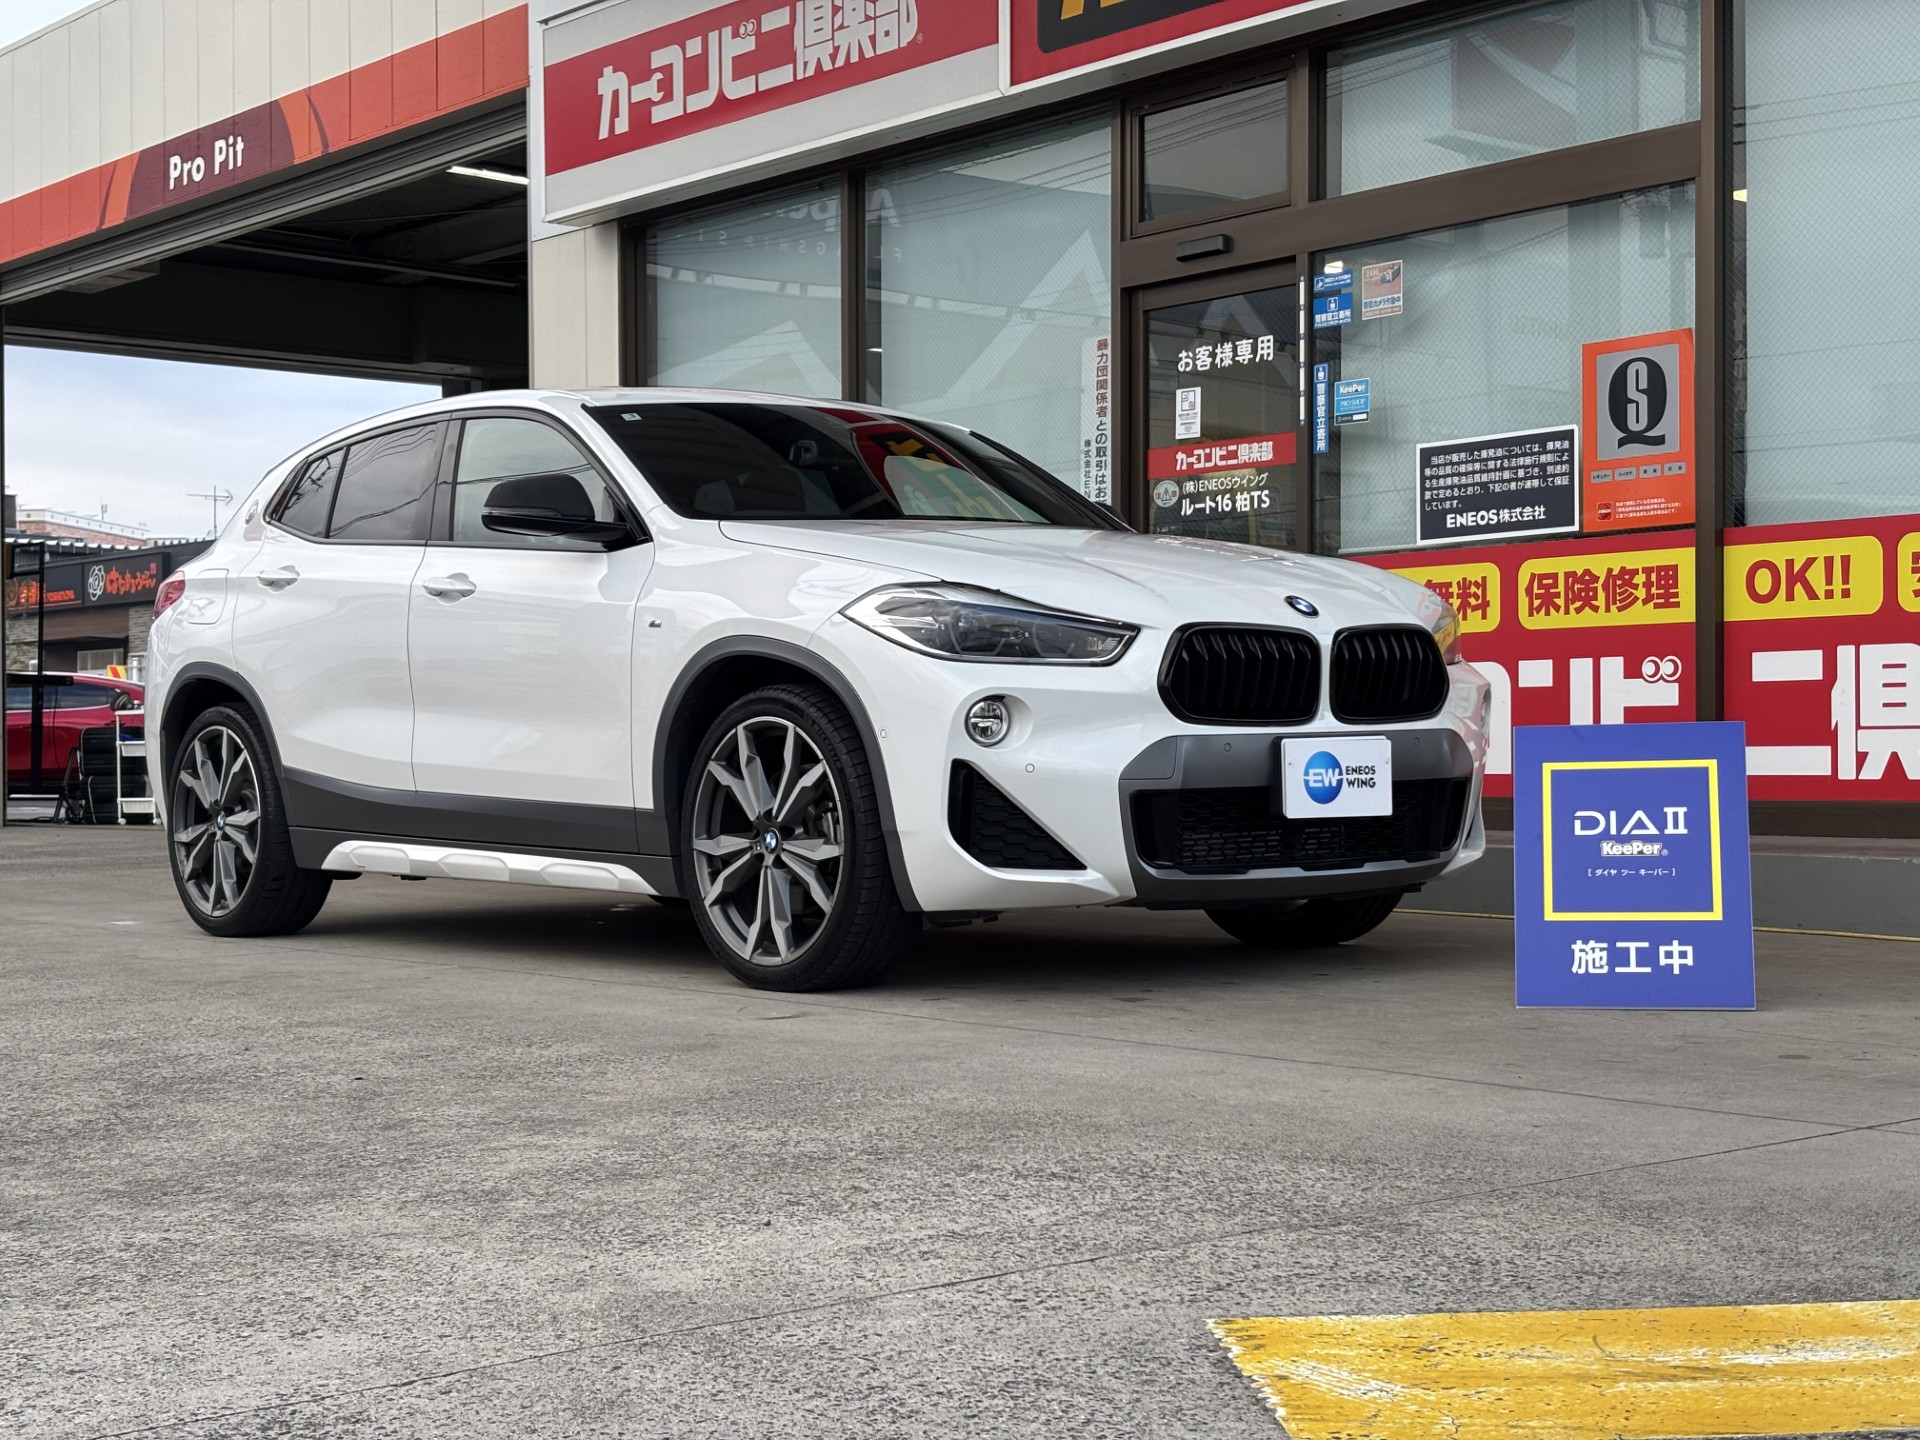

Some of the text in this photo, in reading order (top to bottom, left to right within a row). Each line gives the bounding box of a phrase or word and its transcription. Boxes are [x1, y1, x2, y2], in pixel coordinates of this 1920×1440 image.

[597, 0, 918, 140] カーコンビニ倶楽部
[169, 135, 244, 190] Pro Pit
[1177, 335, 1274, 372] お客様専用
[1339, 383, 1366, 394] KeePer
[1175, 441, 1274, 471] カーコンビニ倶楽部
[1181, 490, 1270, 516] ルート16 柏TS
[1425, 500, 1462, 511] しています。
[1446, 505, 1546, 529] ENEOS株式会社
[1524, 564, 1681, 618] 保険修理
[1744, 554, 1852, 604] OK!!
[1345, 765, 1376, 776] ENEOS
[1346, 777, 1377, 789] WING
[1600, 840, 1663, 857] KeePer
[1594, 868, 1670, 877] ダイヤ ツー キーパー
[1570, 939, 1694, 975] 施工中
